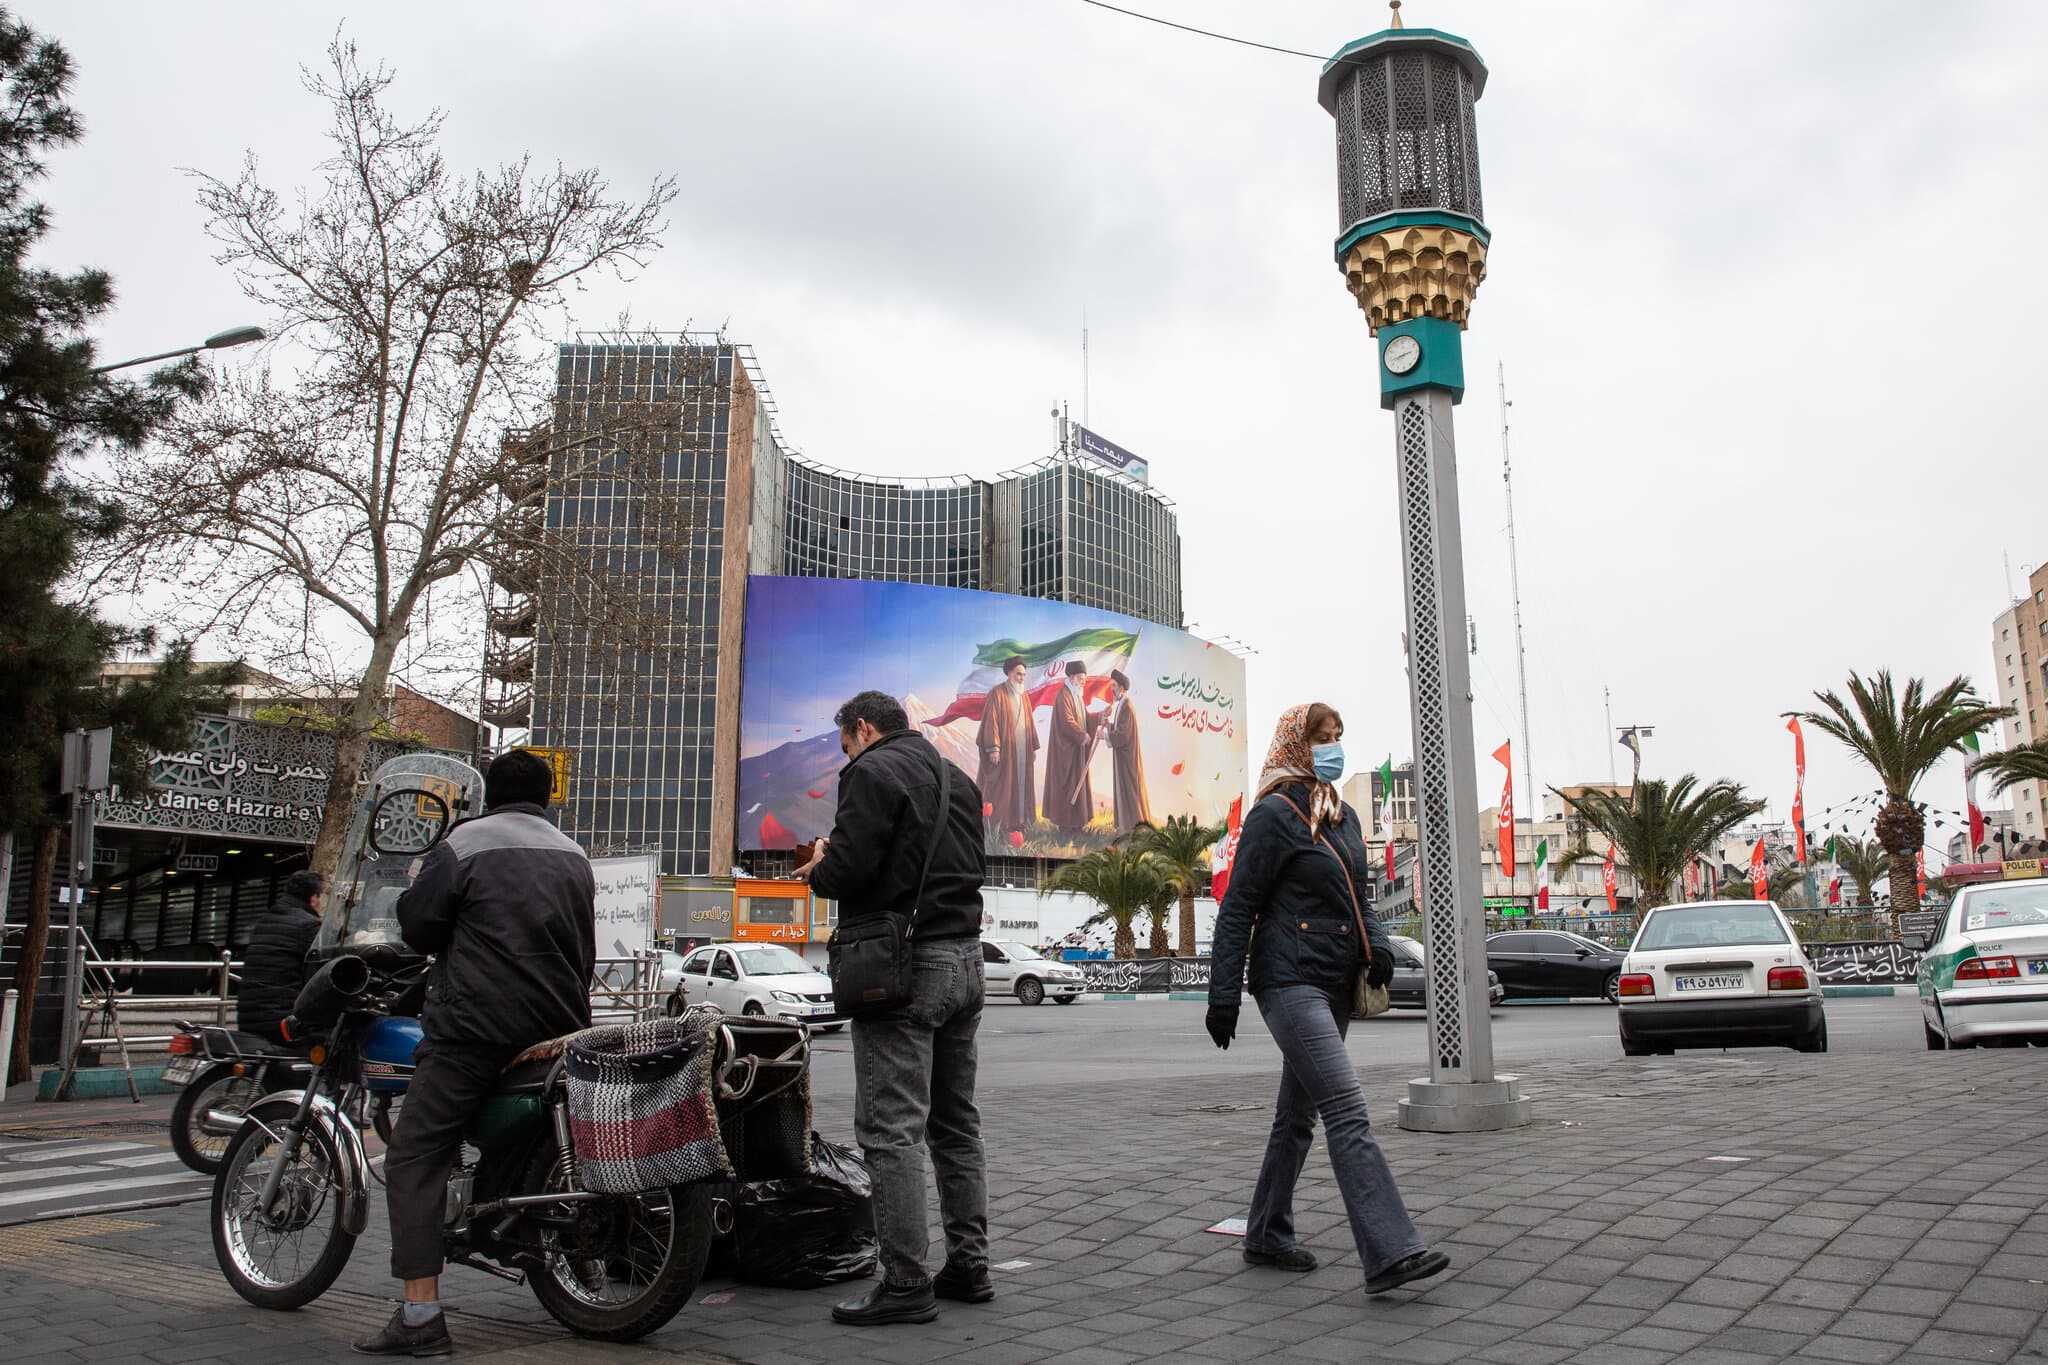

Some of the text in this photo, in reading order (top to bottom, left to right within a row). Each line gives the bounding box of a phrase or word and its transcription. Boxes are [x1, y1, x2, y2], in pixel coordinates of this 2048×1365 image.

[1085, 434, 1124, 465] بیمه سینا
[1157, 671, 1187, 693] ماست
[1157, 703, 1187, 721] ماست
[253, 758, 328, 782] حضرت
[226, 796, 310, 821] Hazrat-e
[2006, 860, 2037, 871] POLICE
[663, 928, 676, 936] 37
[1979, 944, 2002, 952] POLICE
[1684, 978, 1696, 989] ۴۹
[1697, 977, 1706, 988] ق
[1708, 977, 1727, 988] ۵۹۷
